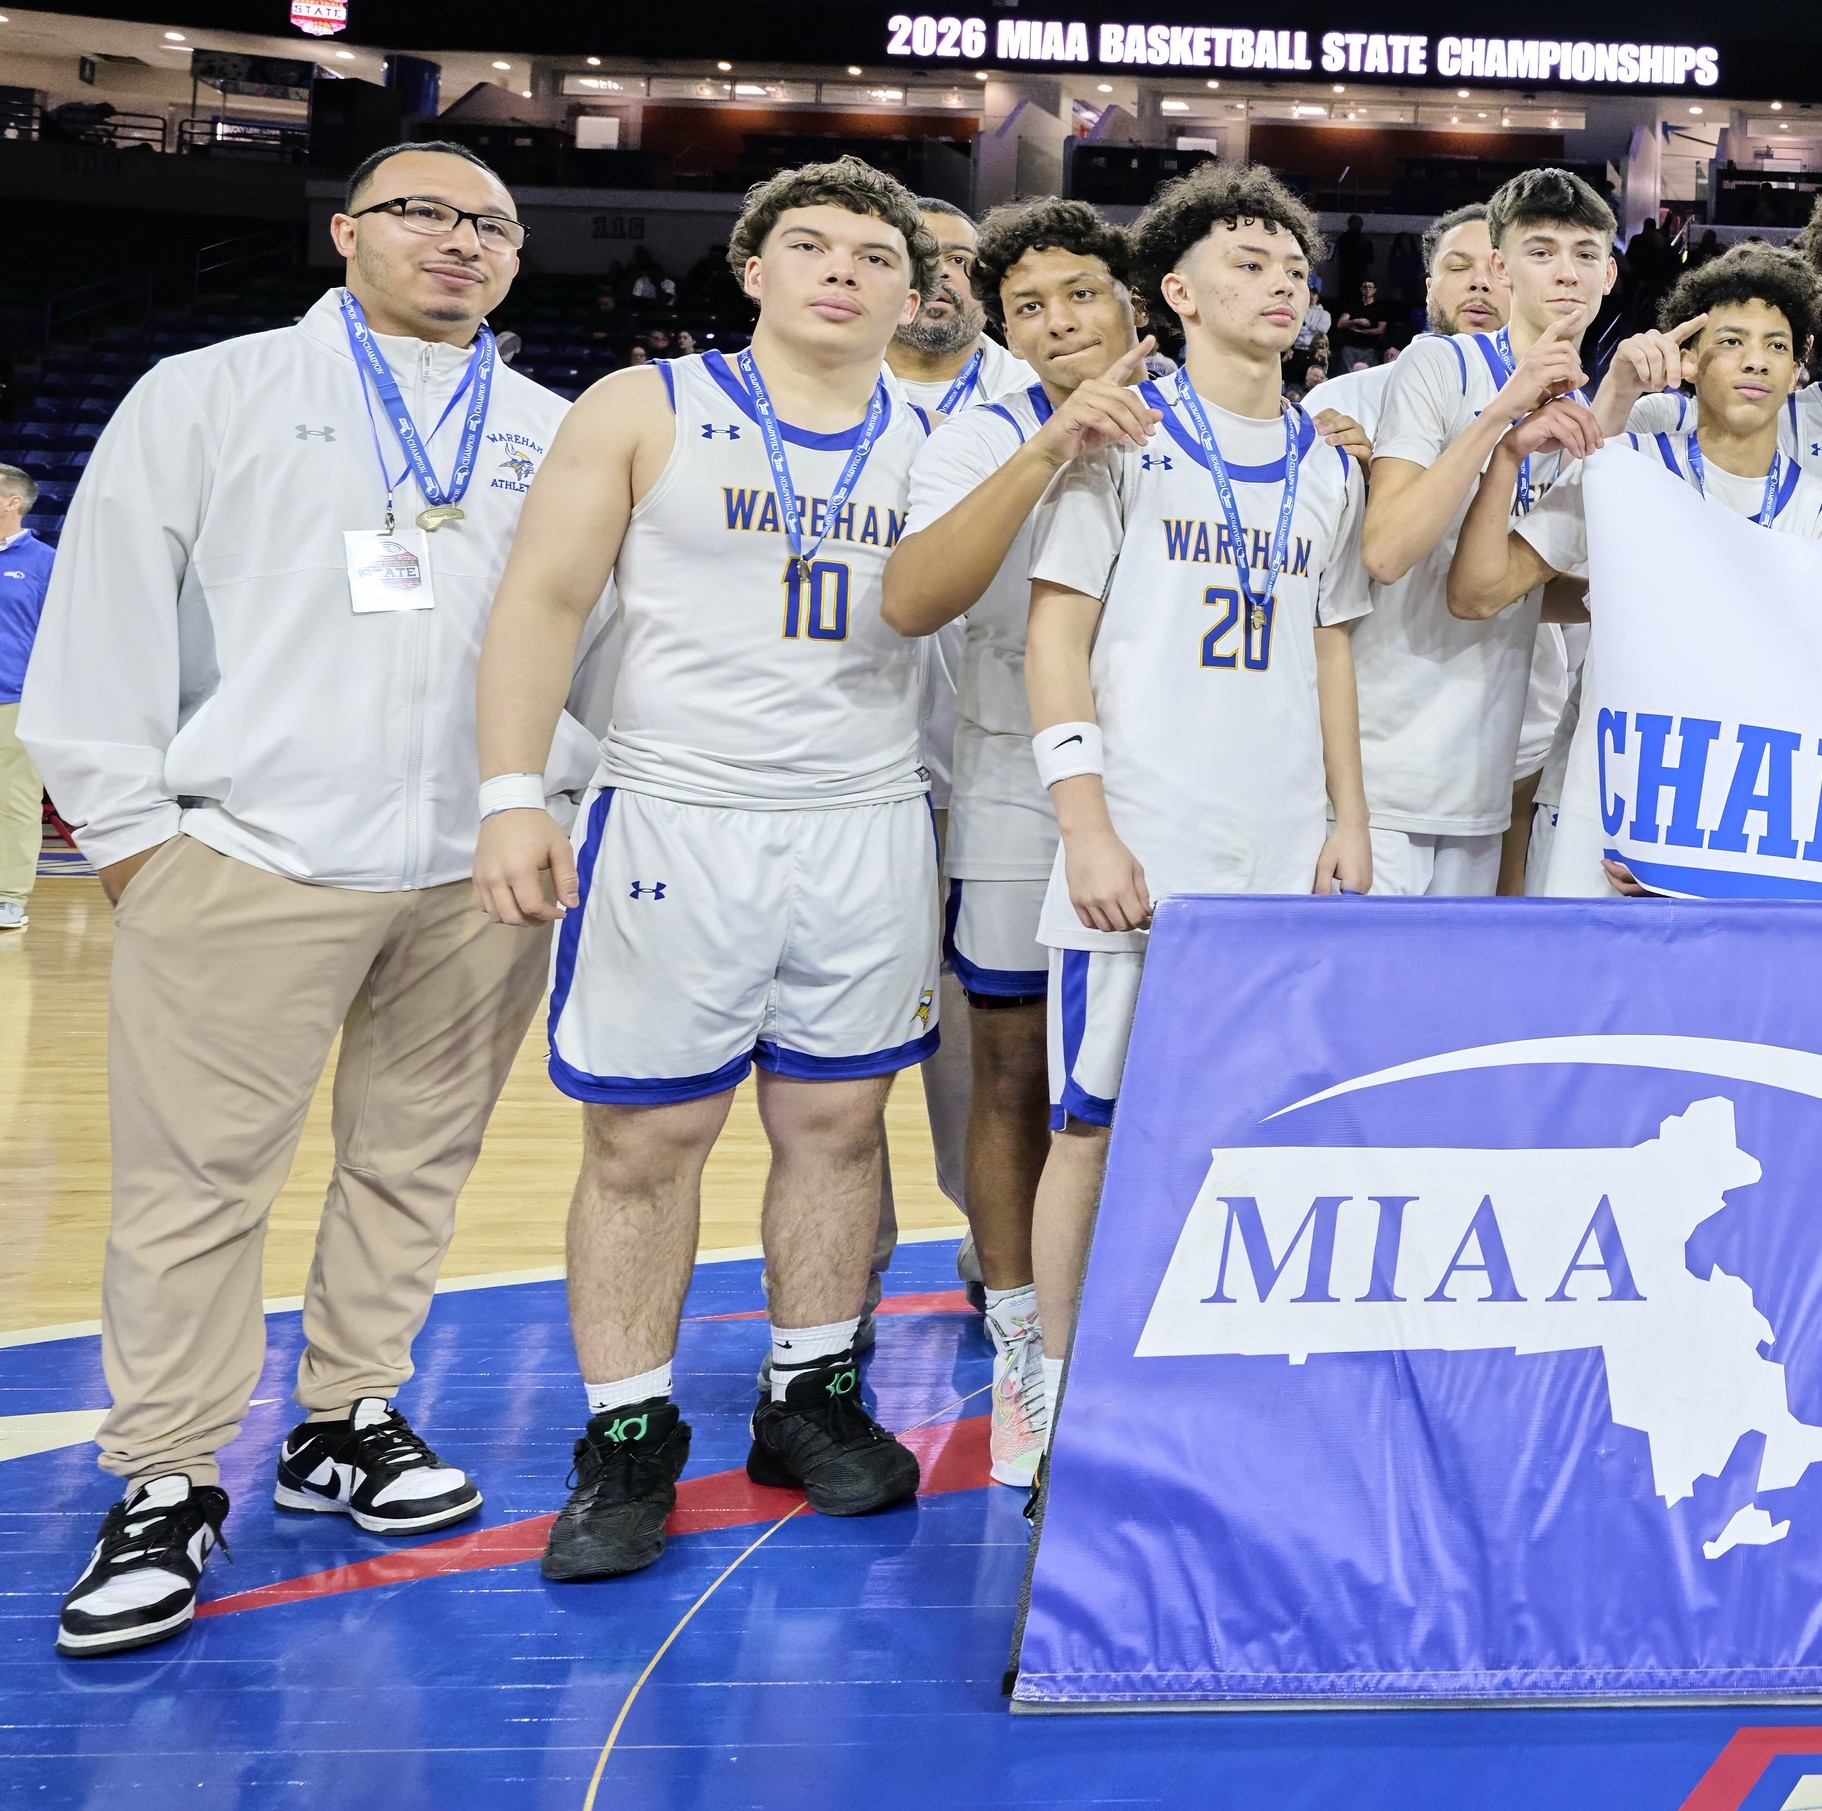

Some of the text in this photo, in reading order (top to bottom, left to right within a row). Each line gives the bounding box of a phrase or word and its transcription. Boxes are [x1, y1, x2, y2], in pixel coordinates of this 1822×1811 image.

[886, 15, 1719, 86] 2026 MIAA BASKETBALL STATE CHAMPIONSHIPS
[362, 341, 385, 376] CHAMPION
[474, 383, 487, 415] CHAMPION
[764, 418, 778, 451] CHAMPION
[1188, 401, 1207, 433] CHAMPION
[408, 438, 428, 475] CHAMPION
[462, 434, 477, 466] CHAMPION
[486, 432, 543, 455] WAREHAM
[490, 479, 530, 494] ATHLET
[843, 454, 862, 485] CHAMPION
[1209, 454, 1227, 488] CHAMPION
[779, 476, 793, 511] CHAMPION
[1229, 512, 1242, 548] CHAMPION
[1277, 514, 1289, 549] CHAMPION
[781, 555, 852, 642] 10
[1200, 585, 1277, 672] 20
[1200, 1193, 1647, 1304] MIAA
